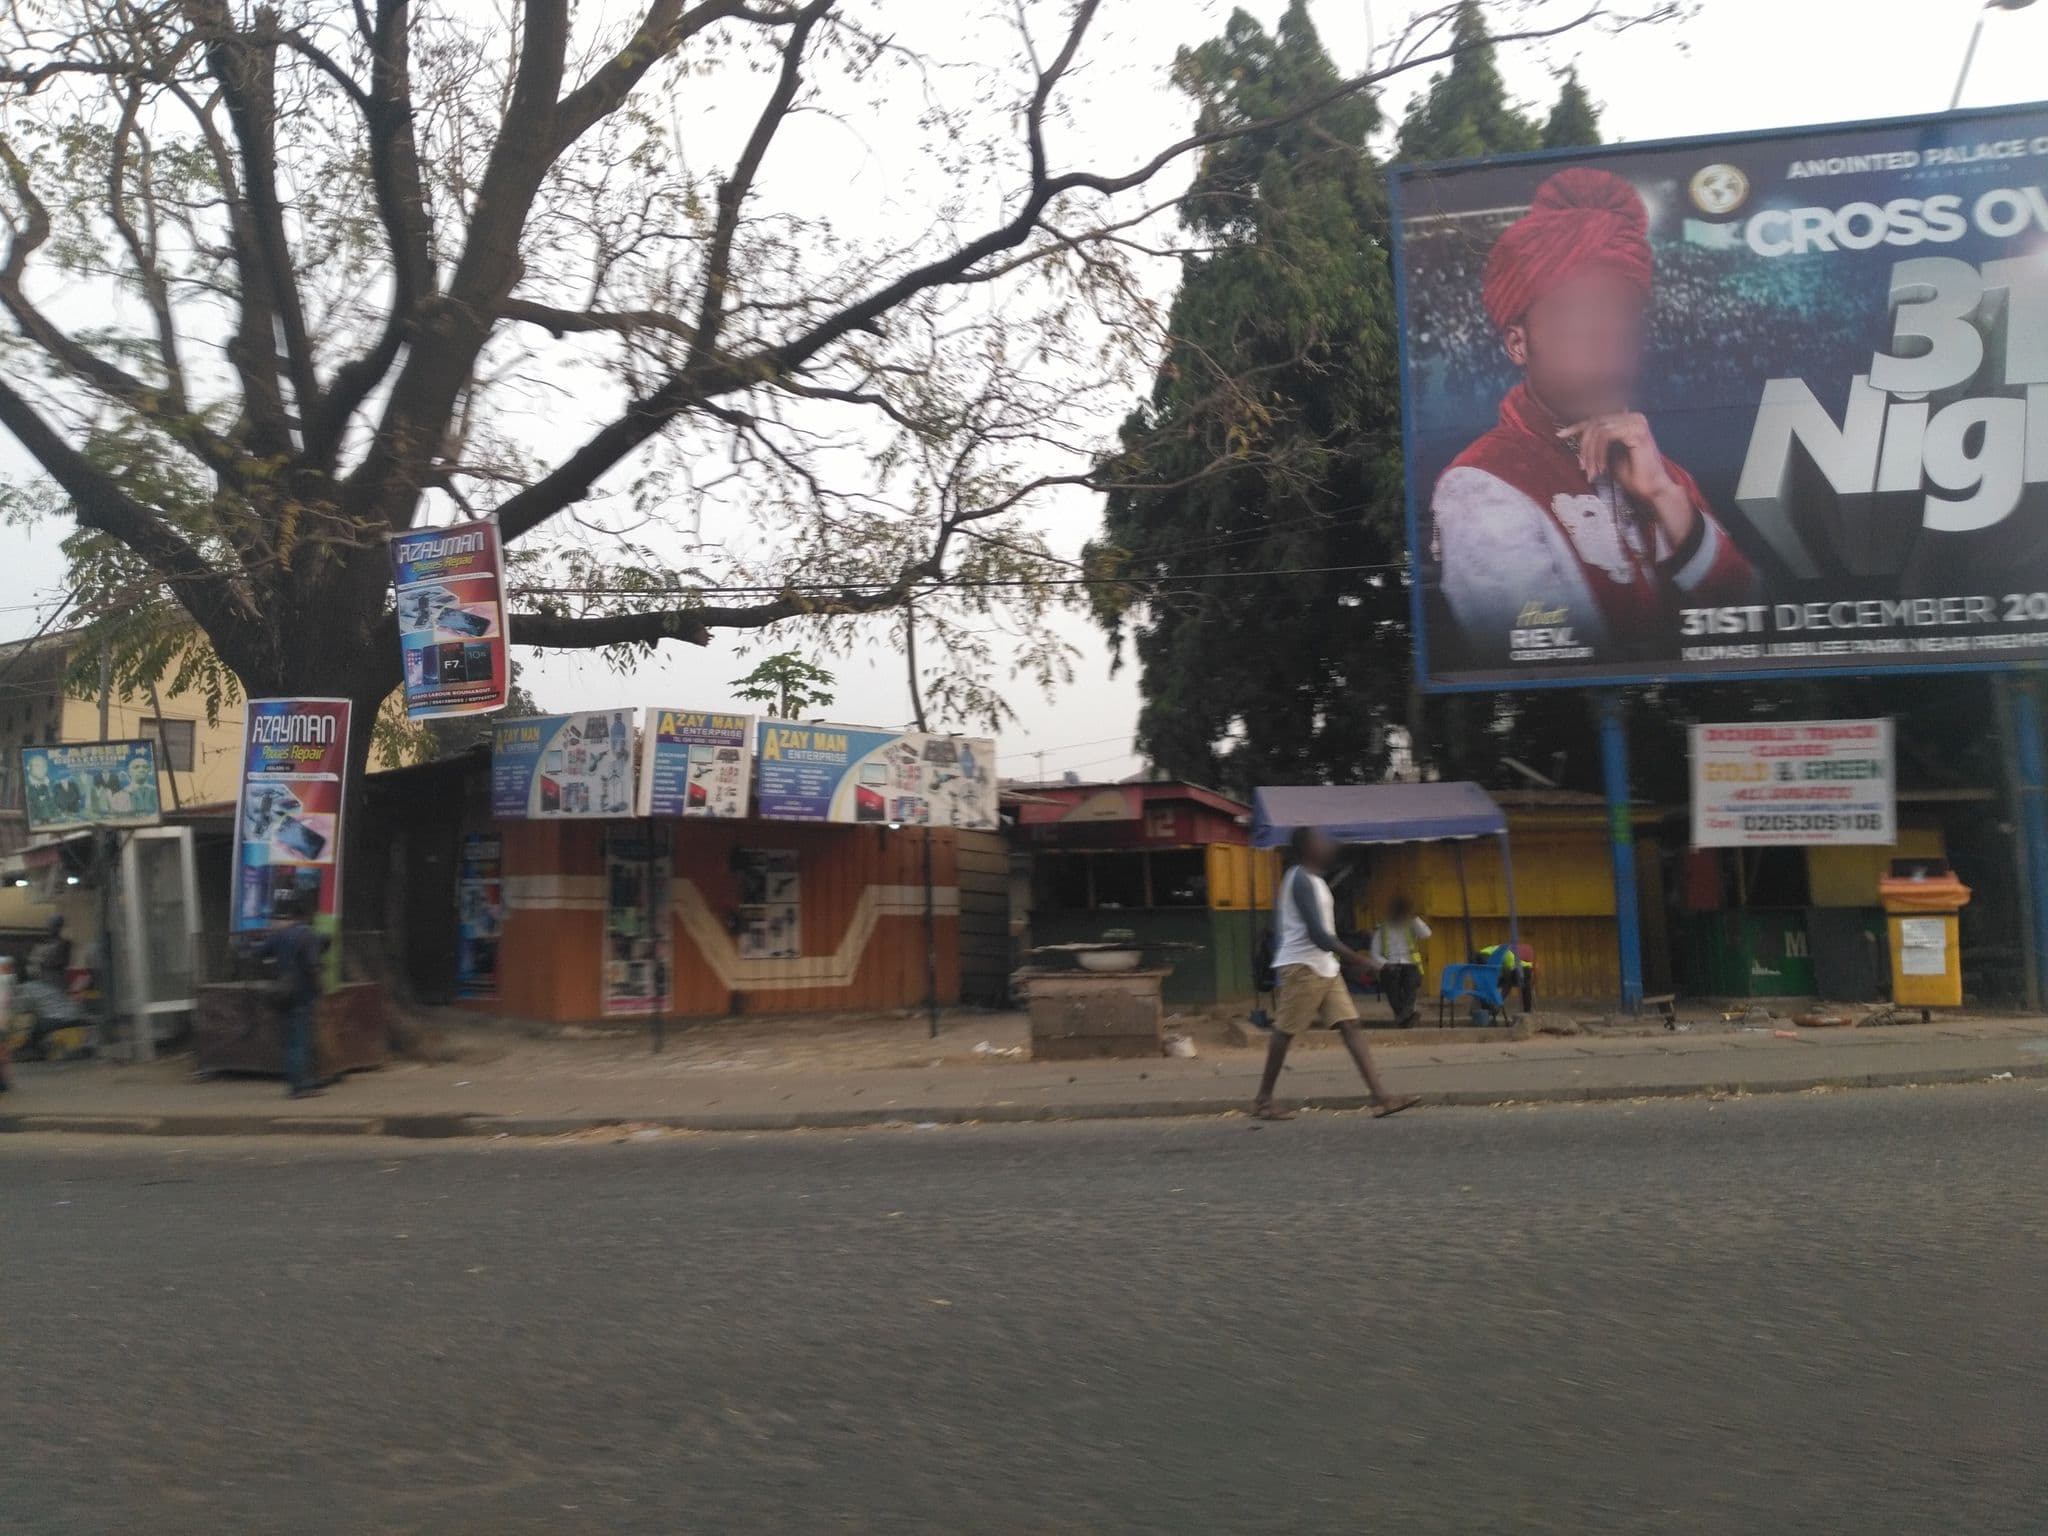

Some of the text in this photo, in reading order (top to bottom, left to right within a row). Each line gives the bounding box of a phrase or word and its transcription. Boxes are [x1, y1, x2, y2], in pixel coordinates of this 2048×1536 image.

[1786, 150, 1920, 180] ANOINTED
[1923, 138, 2028, 166] PALACE
[1745, 194, 1968, 258] CROSS
[400, 531, 485, 564] AZAYMAN
[1679, 605, 1769, 636] 31ST
[1774, 594, 1998, 632] DECEMBER
[252, 714, 336, 743] AZAYMAN
[682, 727, 743, 738] ENTERPRISE
[712, 715, 745, 729] MAN
[291, 744, 325, 763] Repair
[813, 731, 848, 752] MAN
[786, 749, 848, 761] ENTERPRISE
